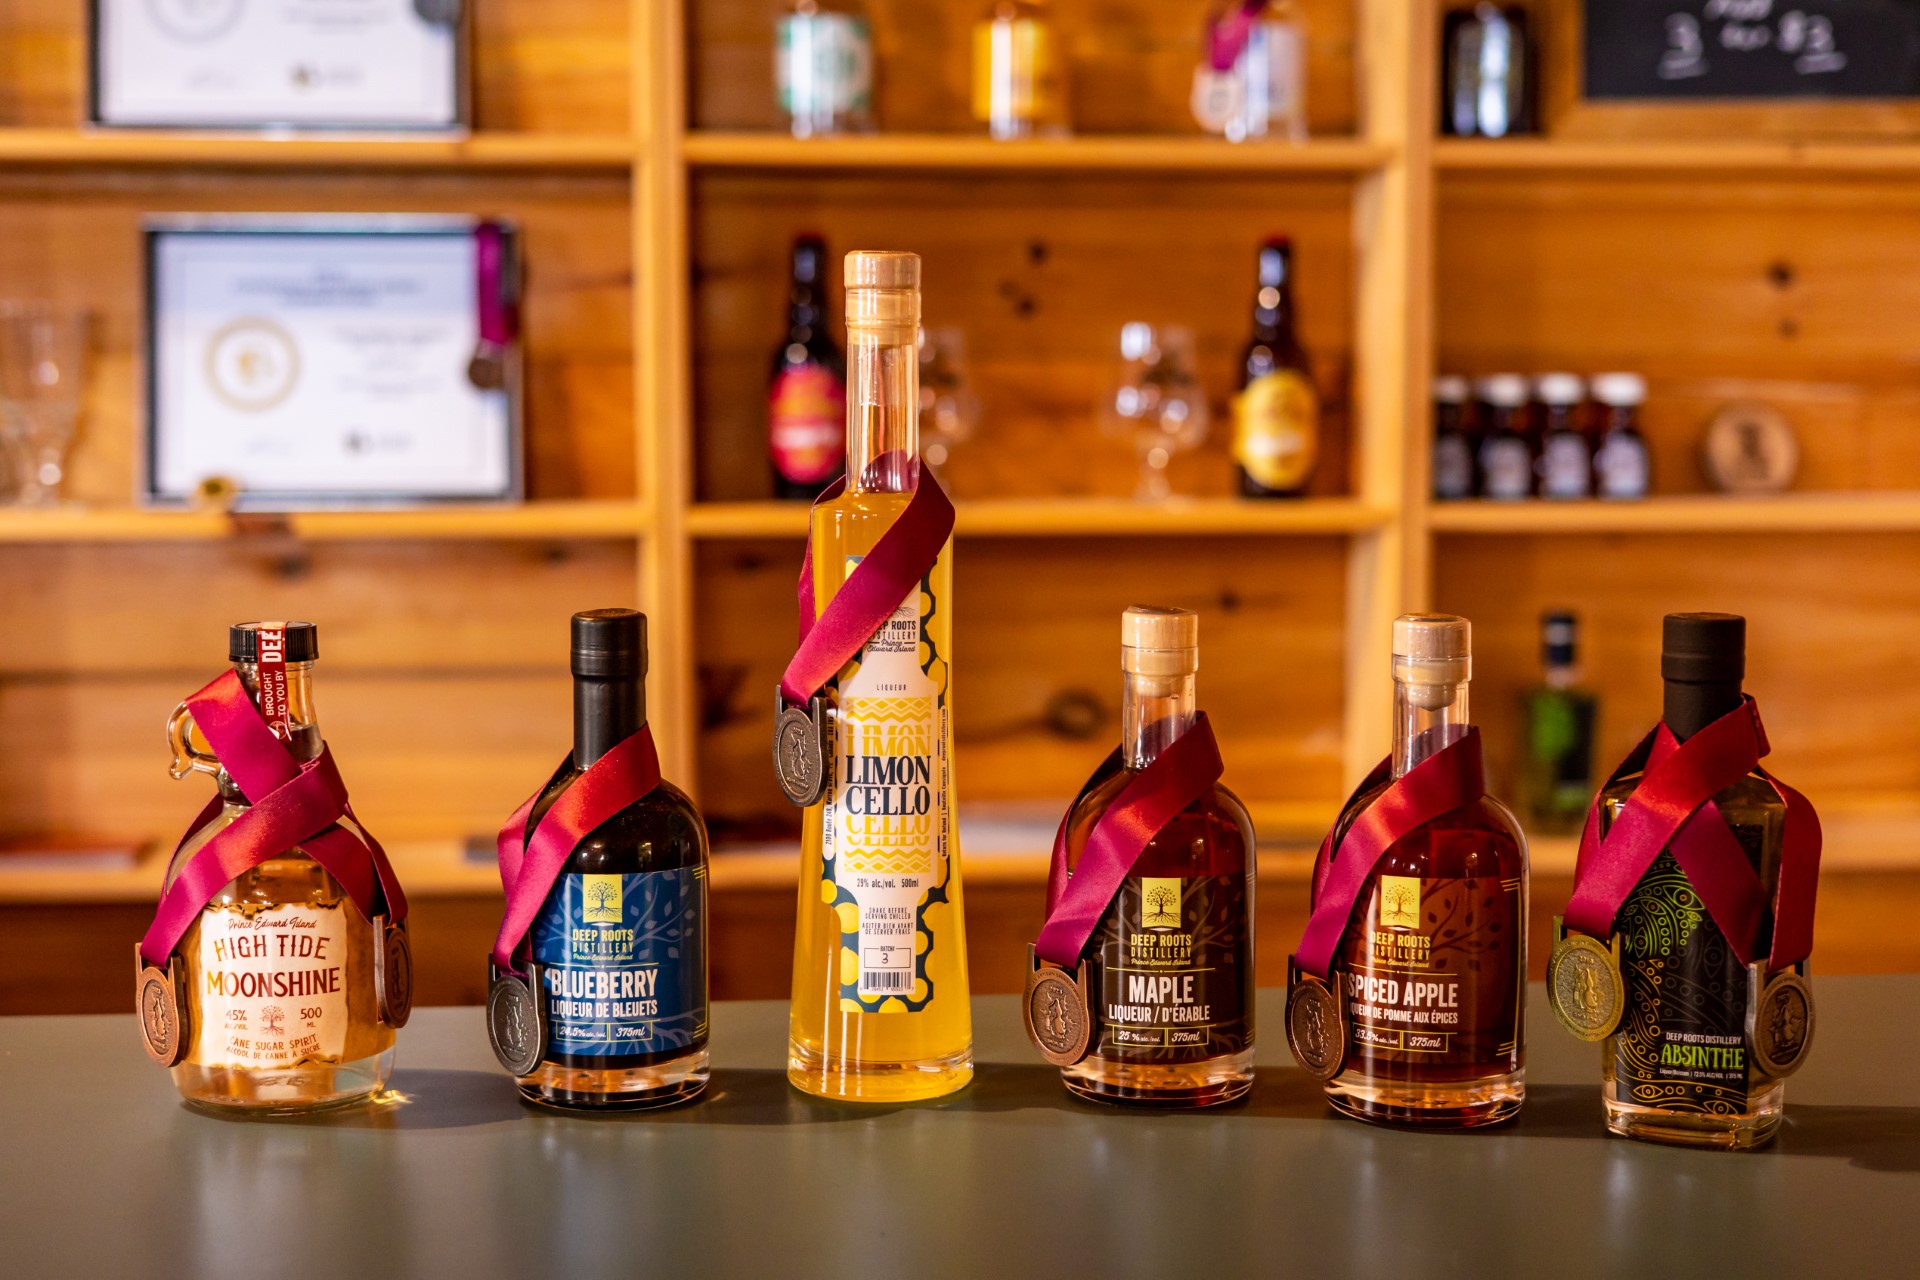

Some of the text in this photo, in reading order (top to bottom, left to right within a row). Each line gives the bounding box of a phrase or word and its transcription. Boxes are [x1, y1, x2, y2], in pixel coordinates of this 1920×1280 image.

[892, 620, 916, 630] ROOTS
[872, 631, 916, 640] ISTILLERY
[881, 639, 902, 647] Prince
[261, 630, 282, 663] DEE
[263, 672, 275, 717] BROUGHT
[274, 670, 286, 717] TO YOU BY
[845, 755, 931, 785] LIMON
[845, 785, 931, 816] CELLO
[901, 878, 919, 888] 500ml
[228, 916, 317, 931] Prince Edward Island
[572, 928, 634, 942] DEEP ROOTS
[1130, 933, 1192, 947] DEEP ROOTS
[1370, 931, 1431, 949] DEEP ROOTS
[214, 934, 331, 962] HIGH TIDE
[572, 941, 634, 953] DISTILLERY
[1130, 946, 1192, 958] DISTILLERY
[1370, 943, 1430, 961] DISTILLERY
[881, 952, 889, 964] 3
[207, 966, 341, 998] MOONSHINE
[551, 968, 658, 999] BLUEBERRY
[1128, 975, 1194, 1004] MAPLE
[1348, 972, 1459, 1008] SPICED APPLE
[225, 1009, 248, 1021] 45%
[300, 1006, 323, 1020] 500
[551, 999, 658, 1019] LIQUEUR DE BLEUETS
[1108, 1003, 1210, 1024] LIQUEUR / D'ÉRABLE
[1350, 1002, 1458, 1024] IQUEUR DE POMME AUX ÉPICES
[559, 1026, 586, 1037] 24.5%
[616, 1026, 646, 1037] 375ml
[1118, 1030, 1131, 1040] 25
[1171, 1031, 1200, 1042] 375ml
[1355, 1028, 1379, 1043] 33.5%
[1410, 1036, 1441, 1048] 375ml
[1666, 1032, 1742, 1045] DEEP ROOTS DISTILLERY
[226, 1046, 249, 1058] ALCOOL
[301, 1042, 321, 1056] SUCRE
[230, 1033, 318, 1051] CANE SUGAR SPIRIT
[1660, 1043, 1745, 1070] ABSINTHE
